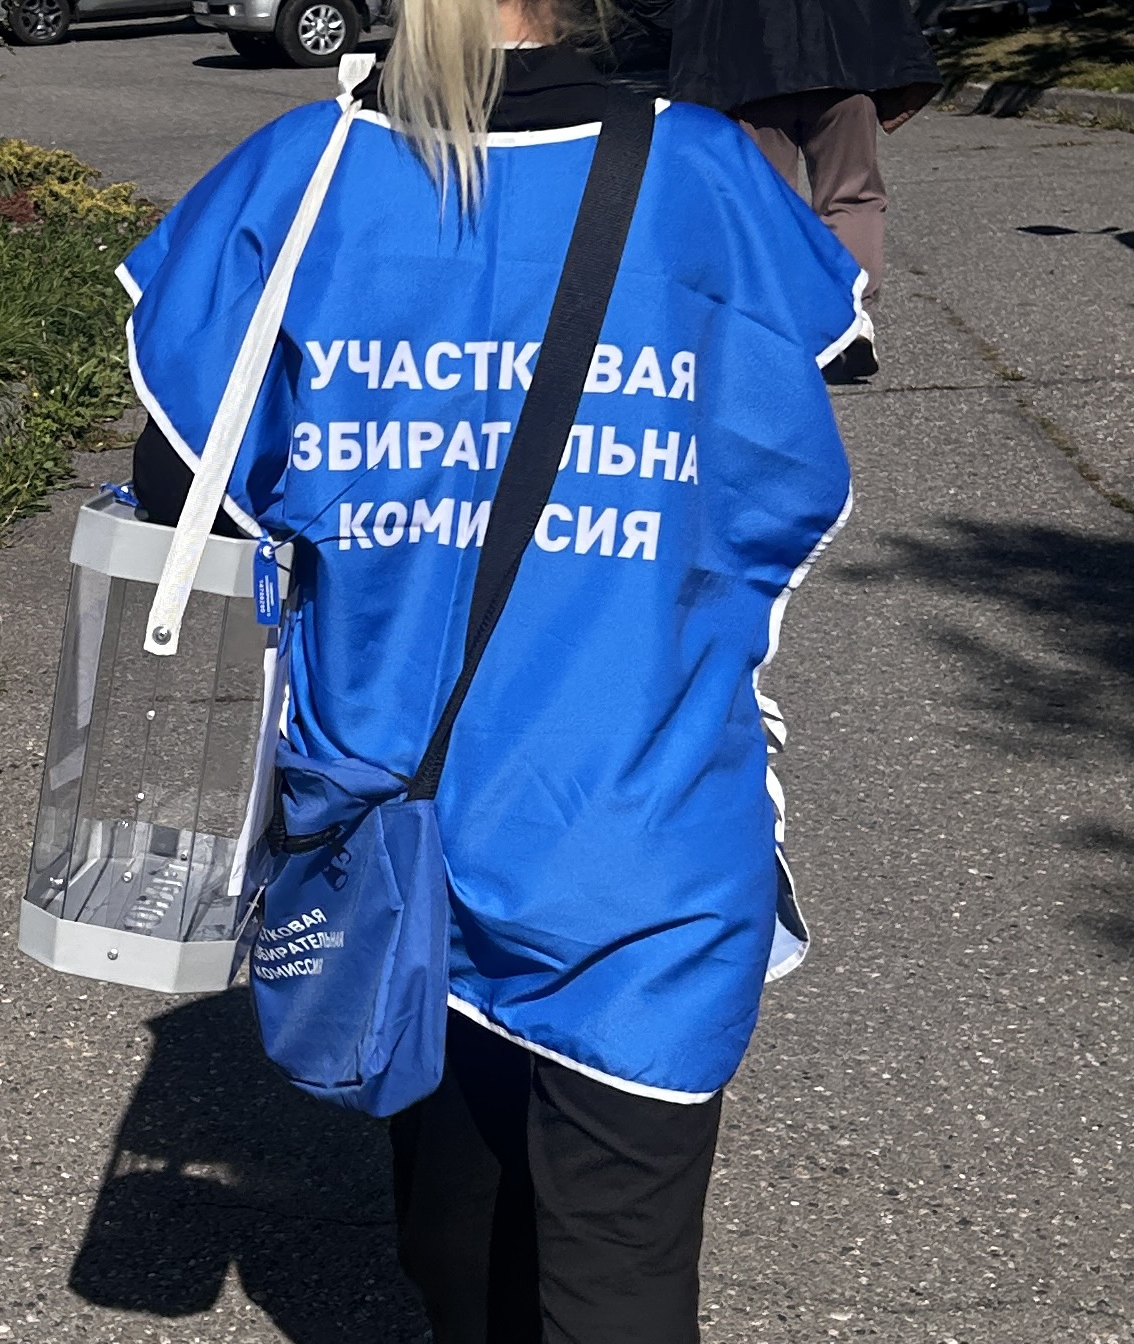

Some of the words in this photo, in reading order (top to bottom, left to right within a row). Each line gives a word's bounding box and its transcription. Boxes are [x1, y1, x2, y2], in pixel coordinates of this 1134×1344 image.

[306, 340, 696, 402] УЧАСТКВАЯ
[287, 421, 698, 485] ЗБИРАТЛЬНА
[338, 497, 662, 561] КОМИСИЯ
